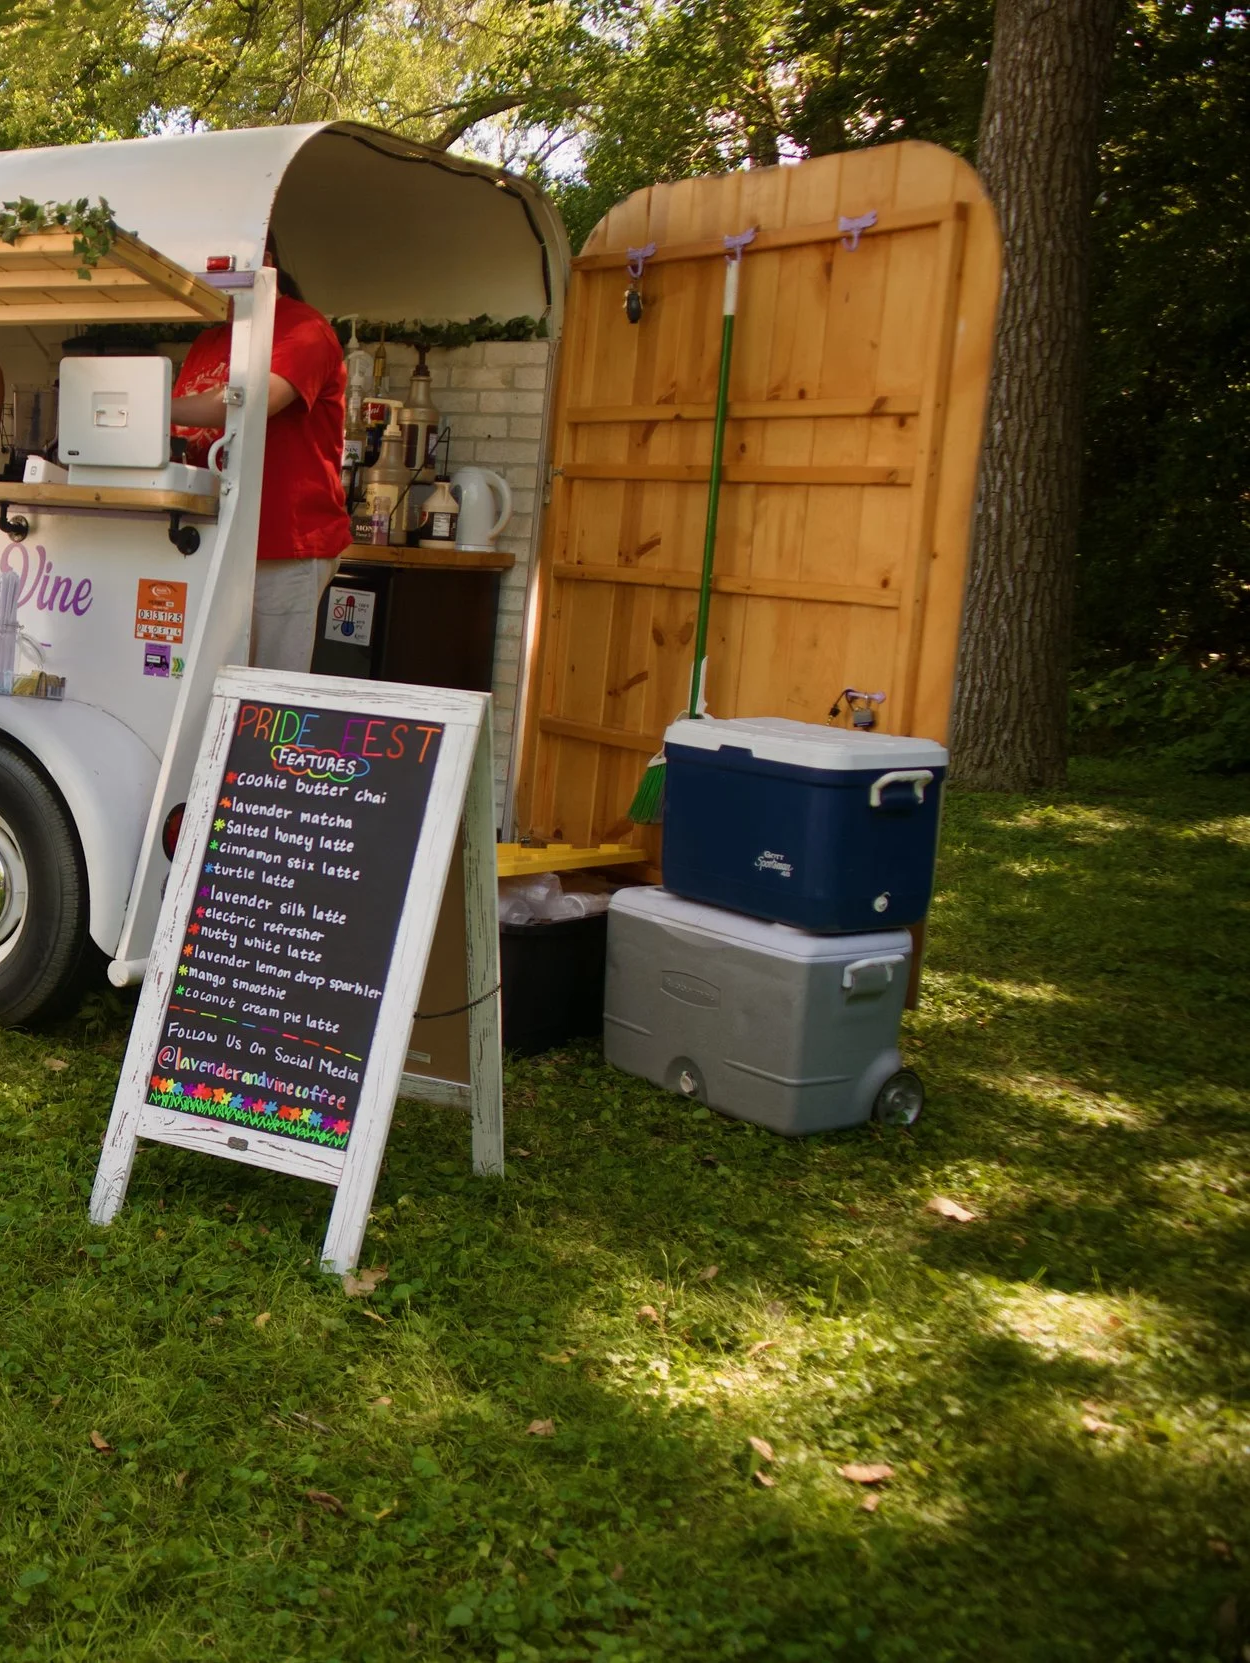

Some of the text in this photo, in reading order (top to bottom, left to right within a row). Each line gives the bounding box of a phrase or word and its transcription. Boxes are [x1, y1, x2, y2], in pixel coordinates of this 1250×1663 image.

[0, 542, 93, 616] Vine
[237, 705, 442, 763] PRIDE FEST
[278, 748, 357, 775] FEATURES
[295, 778, 349, 798] butter
[354, 788, 388, 804] chai
[231, 796, 353, 829] lavender matcha
[226, 820, 355, 853] Salted honey latte
[213, 862, 295, 889] turtle latte
[219, 842, 361, 881] cinnamon stix latte
[210, 884, 347, 925] lavender silk latte
[205, 907, 325, 942] electric refresher
[201, 925, 322, 963] nutty white latte
[188, 965, 287, 1001] mango smoothie
[194, 944, 382, 1001] lavender lemon drop sparkler
[184, 987, 340, 1034] coconut cream pie latte
[226, 1034, 242, 1050] Us
[249, 1041, 267, 1056] On
[275, 1046, 314, 1071] Social
[318, 1058, 360, 1083] Media
